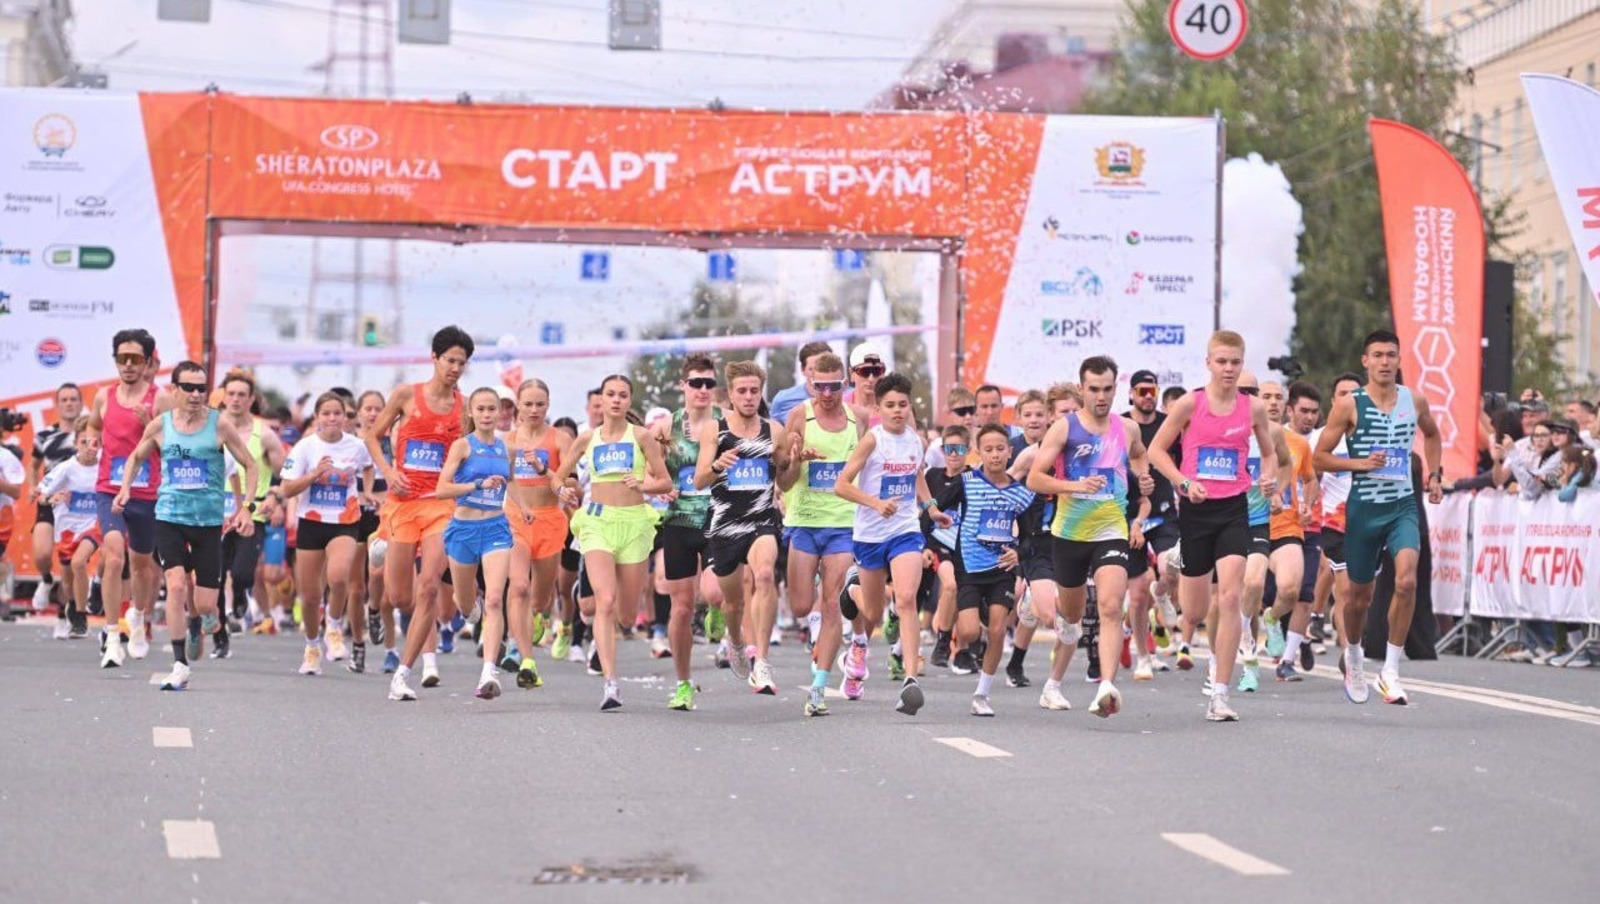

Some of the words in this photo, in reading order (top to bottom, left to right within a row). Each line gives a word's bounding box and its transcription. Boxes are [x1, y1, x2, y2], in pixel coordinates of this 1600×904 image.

[1185, 3, 1231, 35] 40
[336, 128, 364, 148] SP
[255, 153, 442, 180] SHERATONPLAZA
[501, 148, 678, 191] СТАРТ
[729, 163, 931, 197] АСТРУМ
[309, 181, 370, 195] CONGRESS
[1061, 319, 1103, 338] РБК
[411, 448, 439, 461] 6972
[599, 450, 626, 464] 6600
[883, 462, 917, 473] RUSSIA
[1204, 456, 1232, 468] 6602
[173, 467, 201, 478] 5000
[735, 466, 764, 479] 6610
[315, 489, 341, 501] 6105
